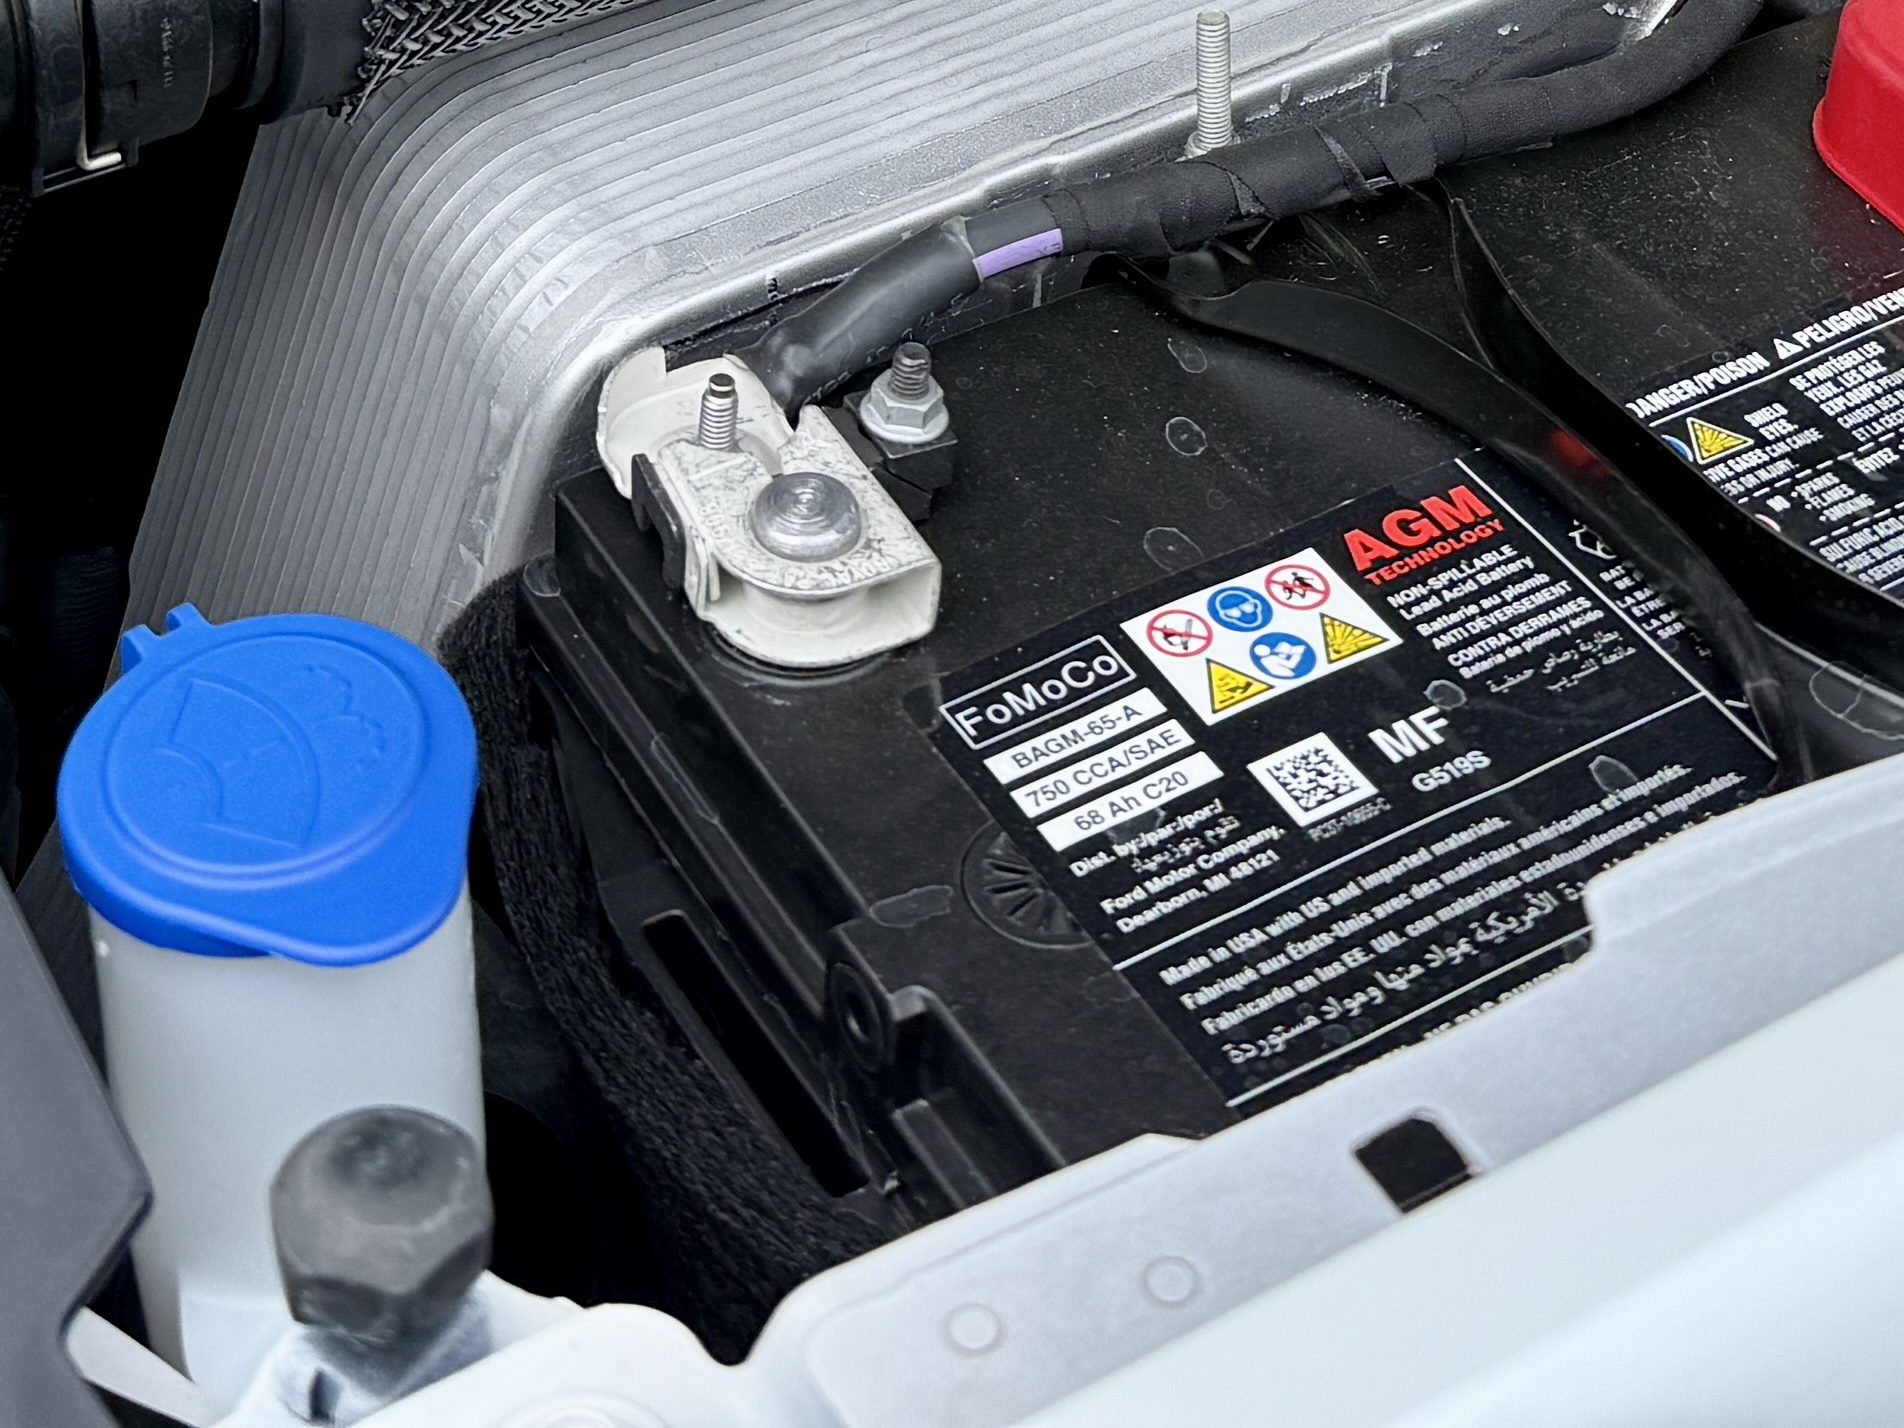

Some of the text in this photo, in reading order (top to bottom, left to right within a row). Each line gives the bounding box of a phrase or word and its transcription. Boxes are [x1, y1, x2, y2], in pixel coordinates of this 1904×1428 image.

[1836, 368, 1865, 388] LES
[1856, 340, 1886, 359] LES
[1344, 485, 1491, 570] AGM
[1365, 518, 1503, 585] TECHNOLOGY
[1386, 543, 1517, 607] NON-SPILLABLE
[1398, 555, 1534, 620] Lead Acid Battery
[1415, 572, 1550, 637] Batterie au plomb
[1431, 626, 1469, 650] ANTI
[1464, 579, 1572, 634] DÉVERSEMENT
[1447, 631, 1513, 666] CONTRA
[1508, 595, 1592, 639] DERRAMES
[1503, 644, 1524, 658] de
[1558, 622, 1572, 635] y
[955, 654, 1118, 736] FoMoCo
[1010, 704, 1142, 768] BAGM-65-A
[1368, 705, 1447, 763] MF
[1024, 728, 1181, 807] 750 CCA/SAE
[1411, 749, 1491, 792] G519S
[1073, 770, 1189, 831] 68 Ah C20
[1068, 850, 1116, 877] Dist.
[1099, 884, 1148, 914] Ford
[1142, 862, 1198, 894] Motor
[1202, 872, 1231, 892] MI
[1229, 848, 1280, 879] 48121
[1159, 816, 1511, 985] Made in USA with US and imported materials.
[1180, 965, 1260, 1010] Fabriqué
[1256, 952, 1291, 975] aux
[1370, 892, 1414, 919] avec
[1409, 877, 1444, 900] des
[1292, 974, 1321, 993] en
[1404, 914, 1440, 937] con
